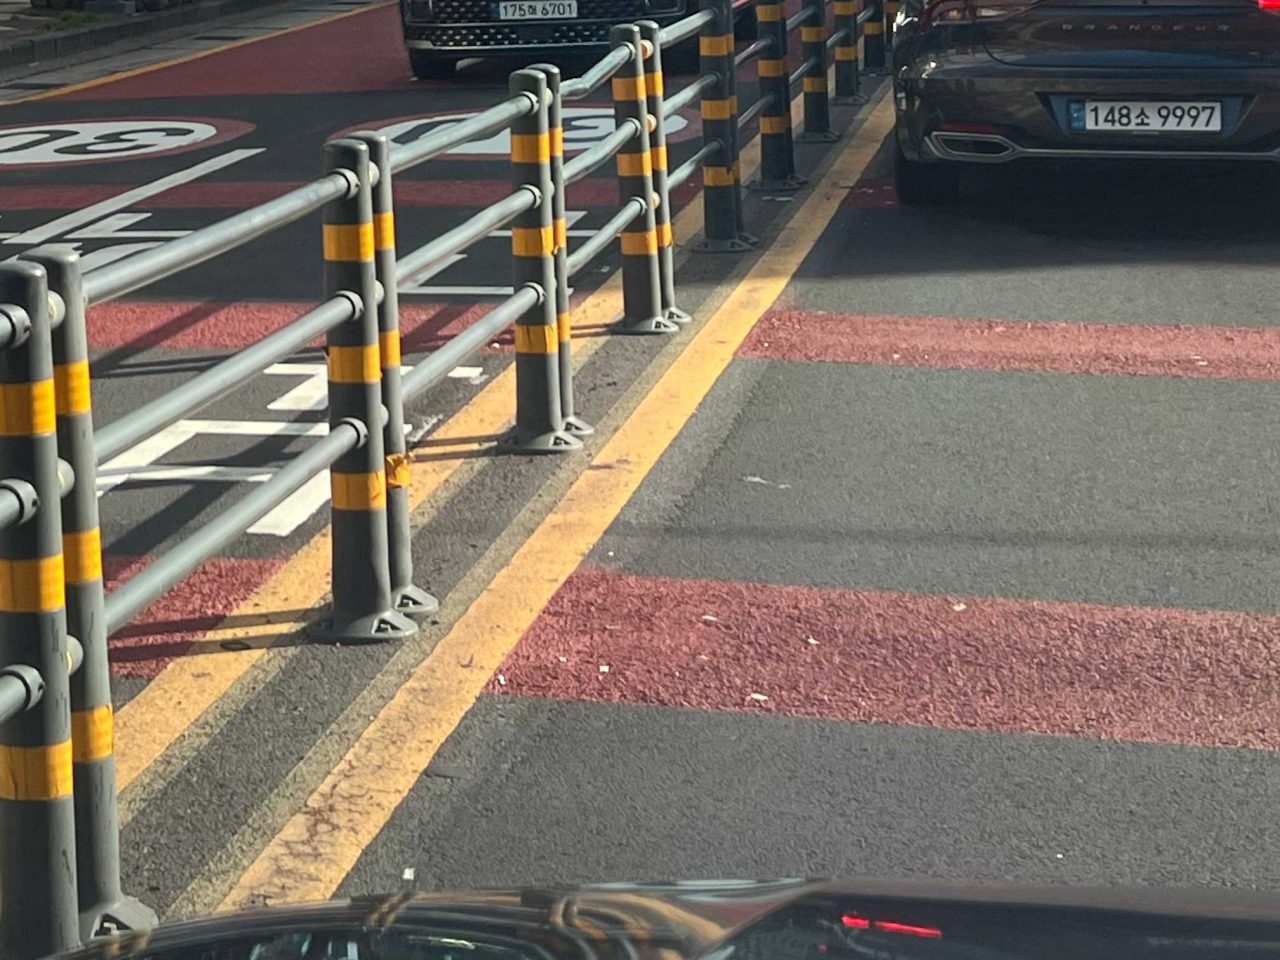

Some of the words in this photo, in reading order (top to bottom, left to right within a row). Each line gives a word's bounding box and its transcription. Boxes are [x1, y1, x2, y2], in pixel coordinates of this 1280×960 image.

[540, 2, 573, 17] 6701
[1089, 105, 1151, 128] 148소
[1157, 105, 1216, 128] 9997
